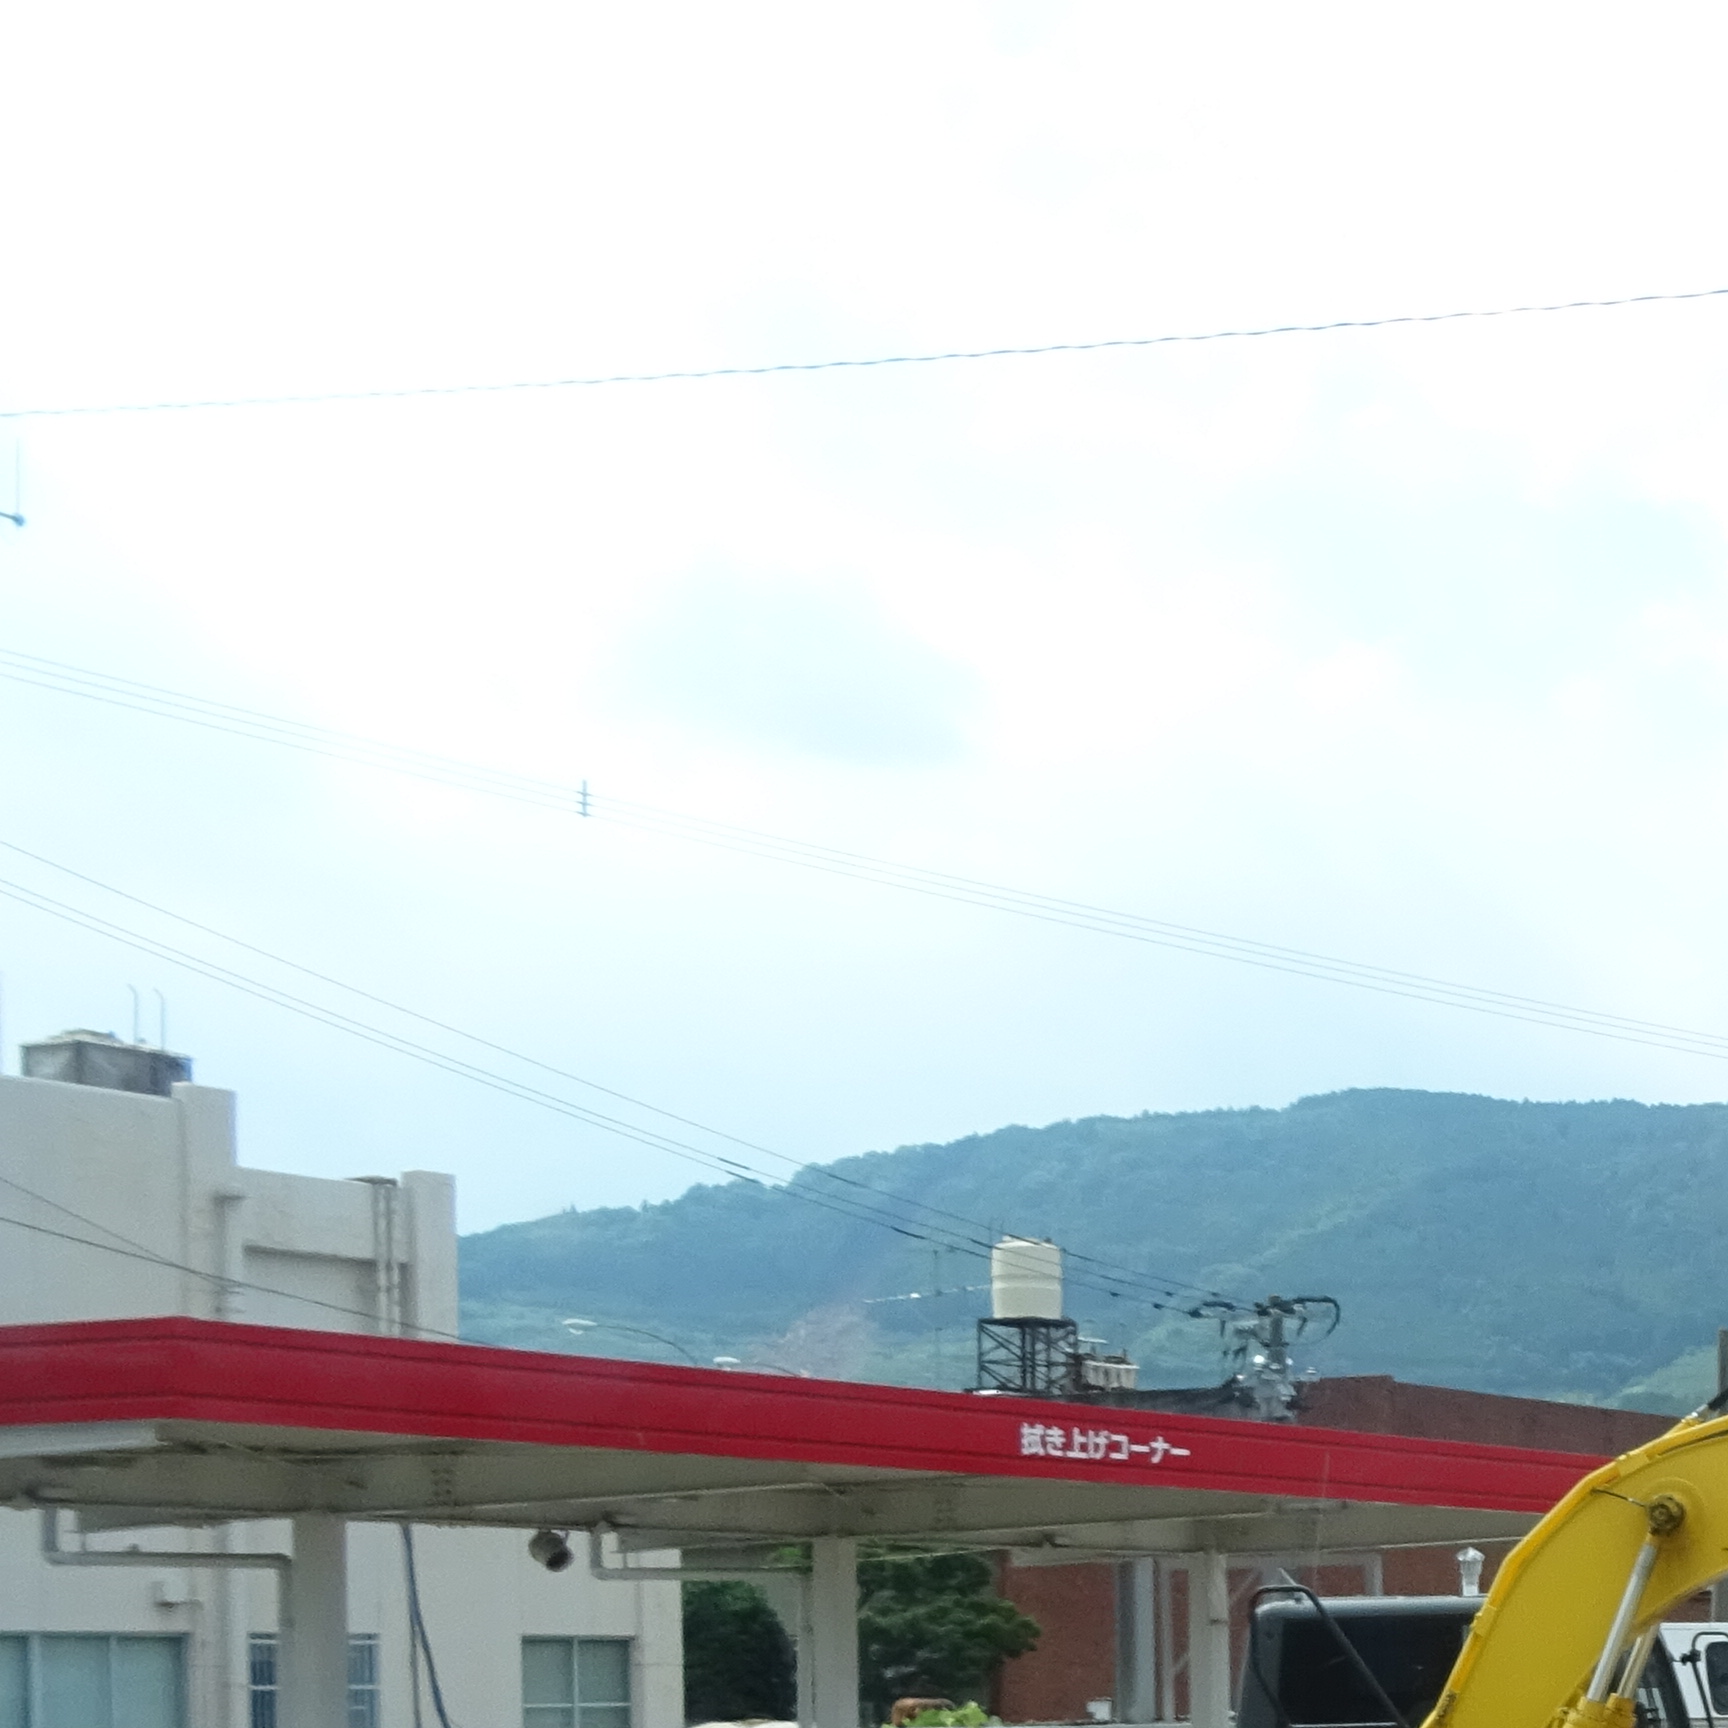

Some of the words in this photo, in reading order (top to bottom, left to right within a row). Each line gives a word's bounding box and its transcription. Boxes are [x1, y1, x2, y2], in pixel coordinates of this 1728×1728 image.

[1020, 1422, 1191, 1464] 拭き上げコーナー
